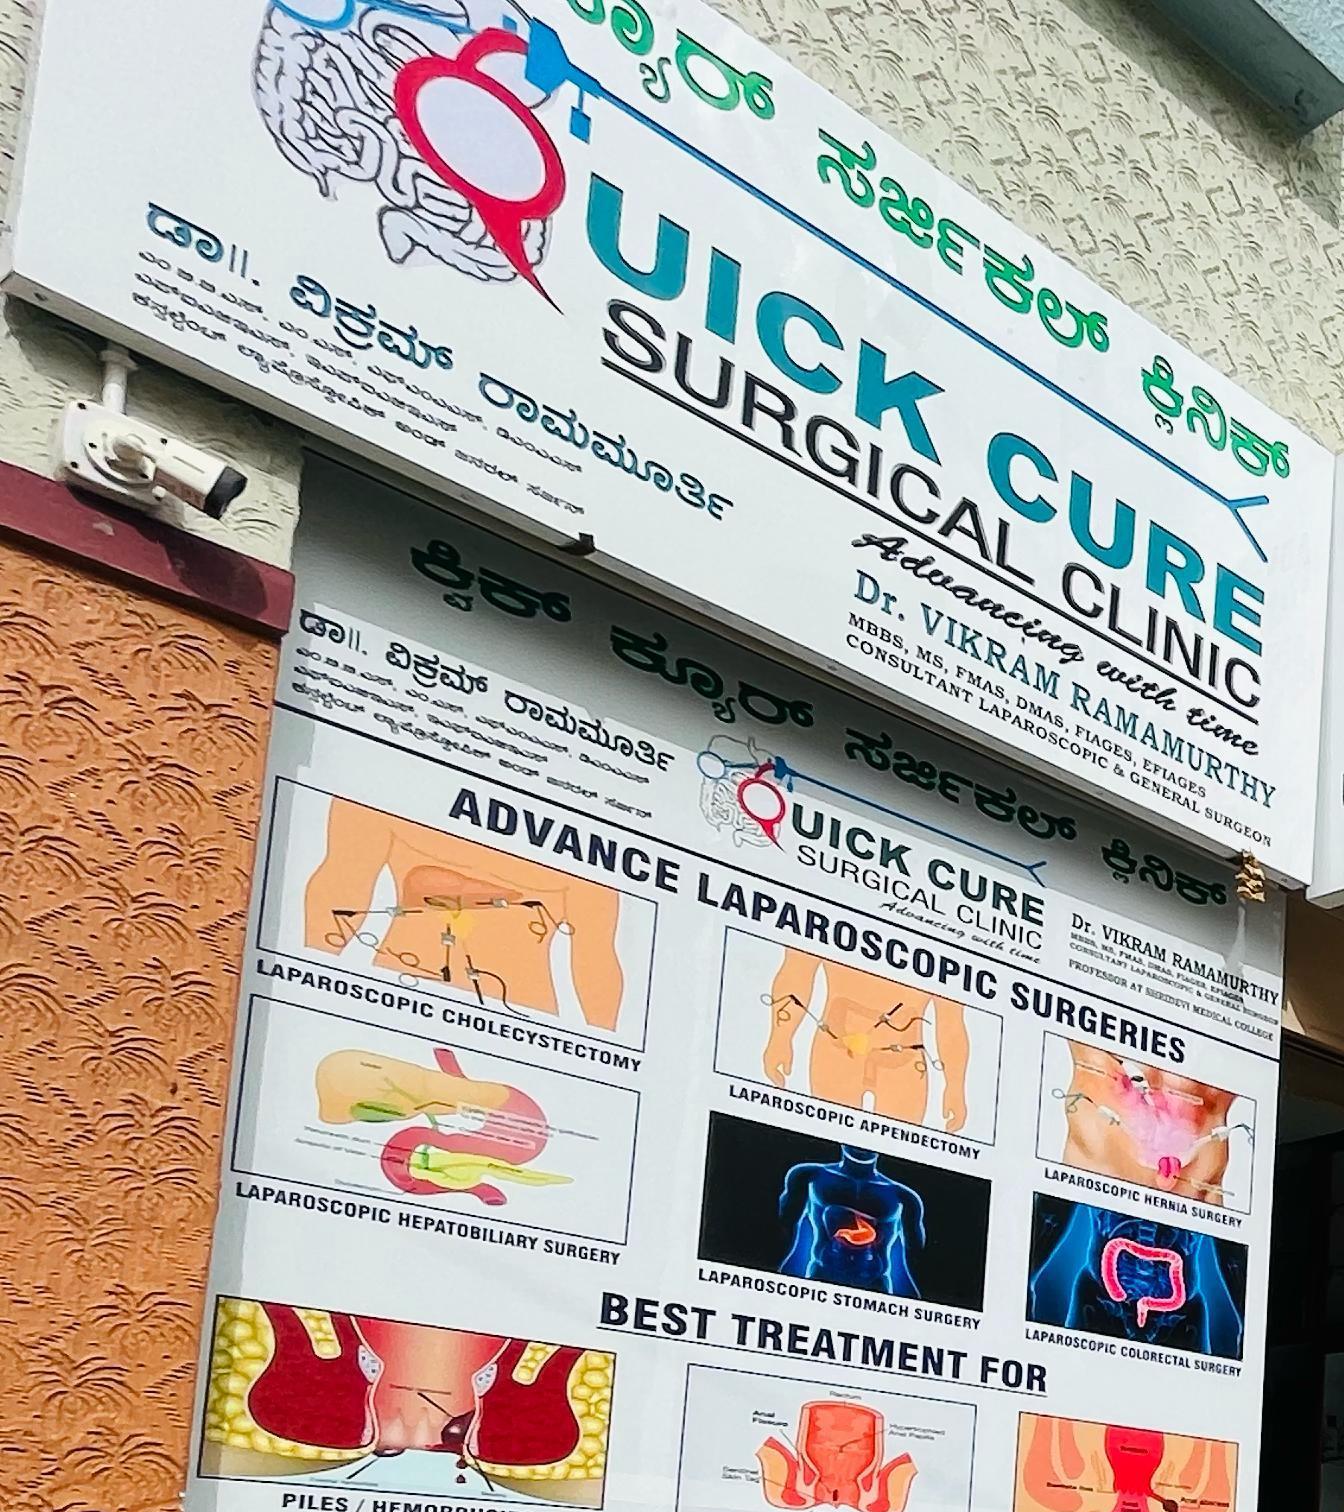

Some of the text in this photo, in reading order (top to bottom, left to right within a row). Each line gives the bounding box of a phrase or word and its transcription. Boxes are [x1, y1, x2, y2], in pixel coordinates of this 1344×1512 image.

[289, 273, 454, 374] ವಿಕ್ರಮ್
[602, 299, 1260, 708] SURGICAL CLINIC
[987, 433, 1266, 657] CURE
[852, 532, 1259, 756] Advancing with time
[854, 569, 1277, 809] Dr. VIKRAM RAMAMURTHY
[846, 633, 1272, 847] CONSULTANT LAPAROSCOPIC GENERAL SURGEON
[449, 788, 680, 894] ADVANCE
[698, 872, 997, 999] LAPAROSCOPIC
[1010, 983, 1186, 1064] SURGERIES
[257, 958, 642, 1072] LAPAROSCOPIC CHOLECYSTECTOMY
[1069, 959, 1127, 987] PROFESSOR
[1193, 1004, 1232, 1025] MEDICAL
[1234, 1020, 1274, 1041] COLLEGE
[859, 1119, 981, 1159] APPENDECTOMY
[235, 1182, 620, 1266] LAPAROSCOPIC HEPATOBILIARY SURGERY
[1044, 1168, 1243, 1228] LAPAROSCOPIC HERNIA SURGERY
[600, 1292, 1047, 1393] BEST TREATMENT FOR
[698, 1268, 909, 1318] LAPAROSCOPIC STOMACH
[1120, 1343, 1242, 1378] COLORECTAL SURGERY
